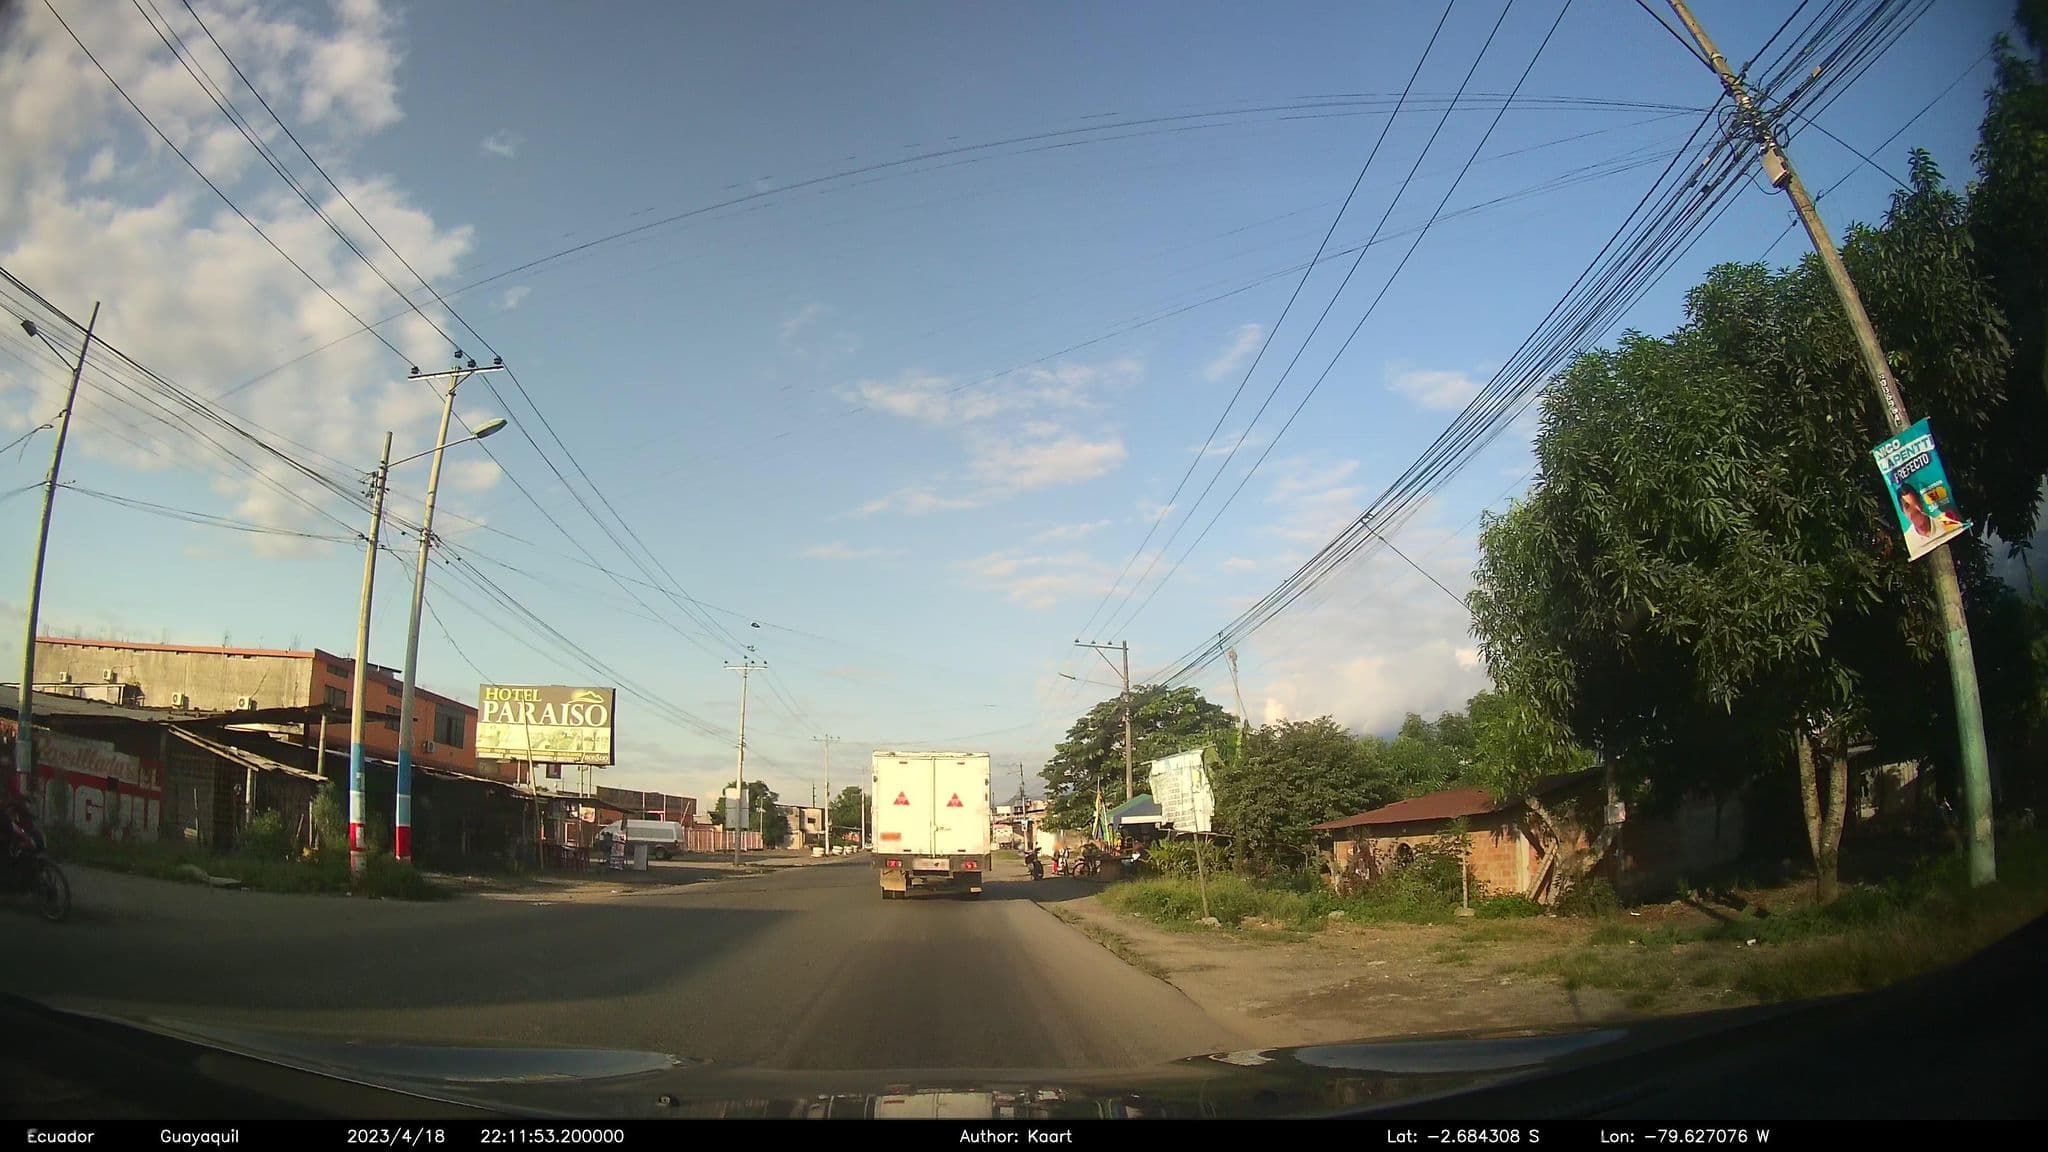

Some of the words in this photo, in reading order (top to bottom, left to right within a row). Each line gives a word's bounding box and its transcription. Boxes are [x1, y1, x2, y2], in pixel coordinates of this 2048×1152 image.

[1875, 439, 1900, 459] NICO
[1880, 434, 1935, 471] LAPENTTI
[1894, 453, 1930, 484] PREFECTO
[485, 687, 542, 702] HOTEL
[482, 700, 608, 728] PARAISO
